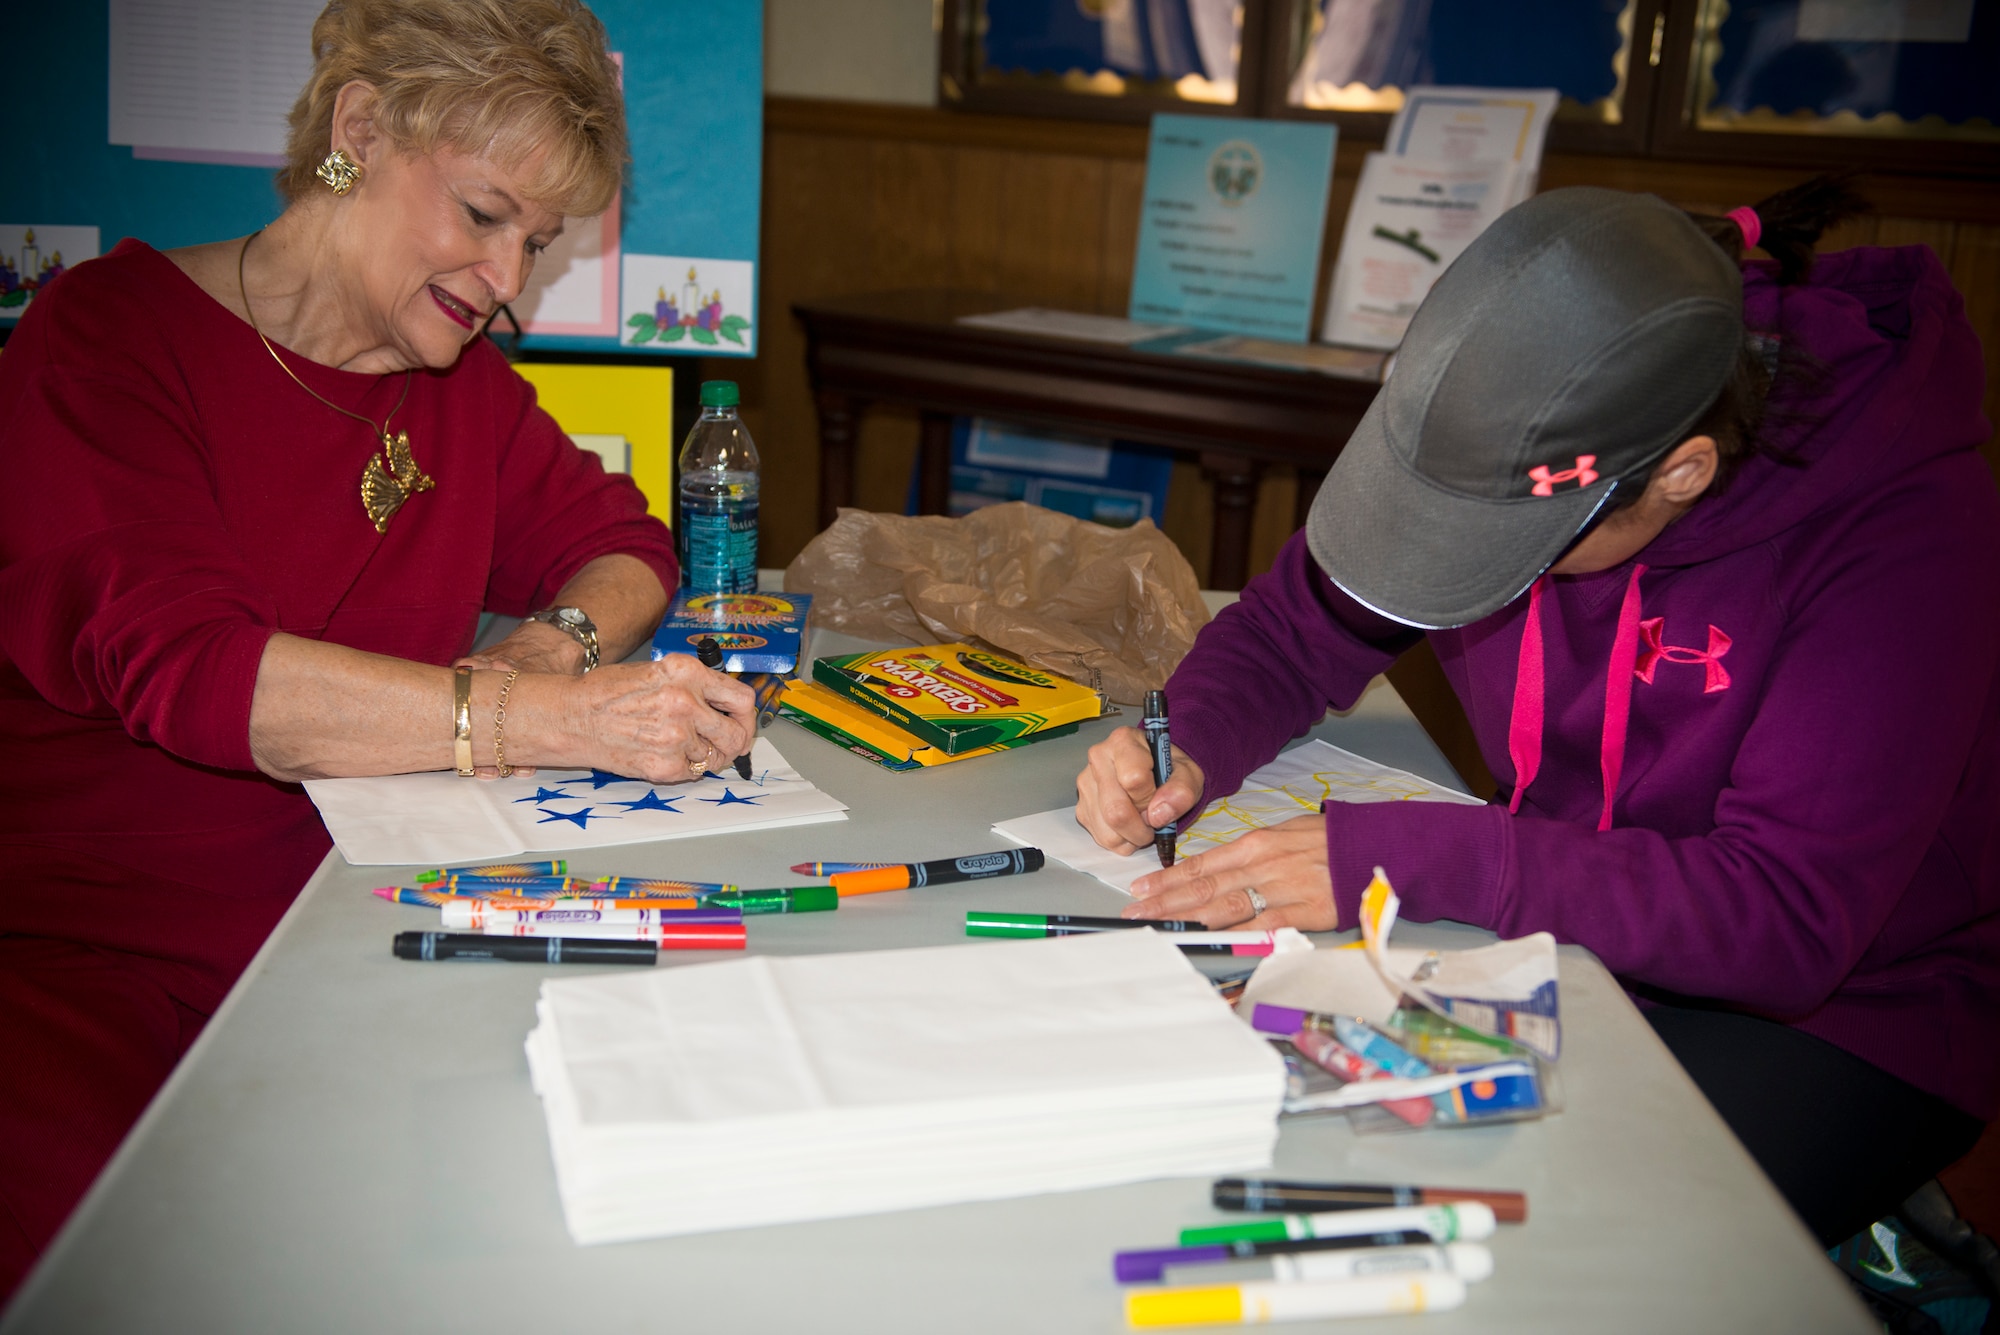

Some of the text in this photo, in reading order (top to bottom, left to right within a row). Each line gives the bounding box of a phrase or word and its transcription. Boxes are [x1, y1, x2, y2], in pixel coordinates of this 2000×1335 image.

[967, 653, 1053, 685] Crayola
[871, 660, 986, 712] MARKERS
[892, 687, 914, 697] 10
[855, 689, 873, 703] CRAYOLA
[873, 699, 889, 712] CLASSI
[890, 709, 910, 725] MARKERS
[960, 855, 1004, 870] Crayola
